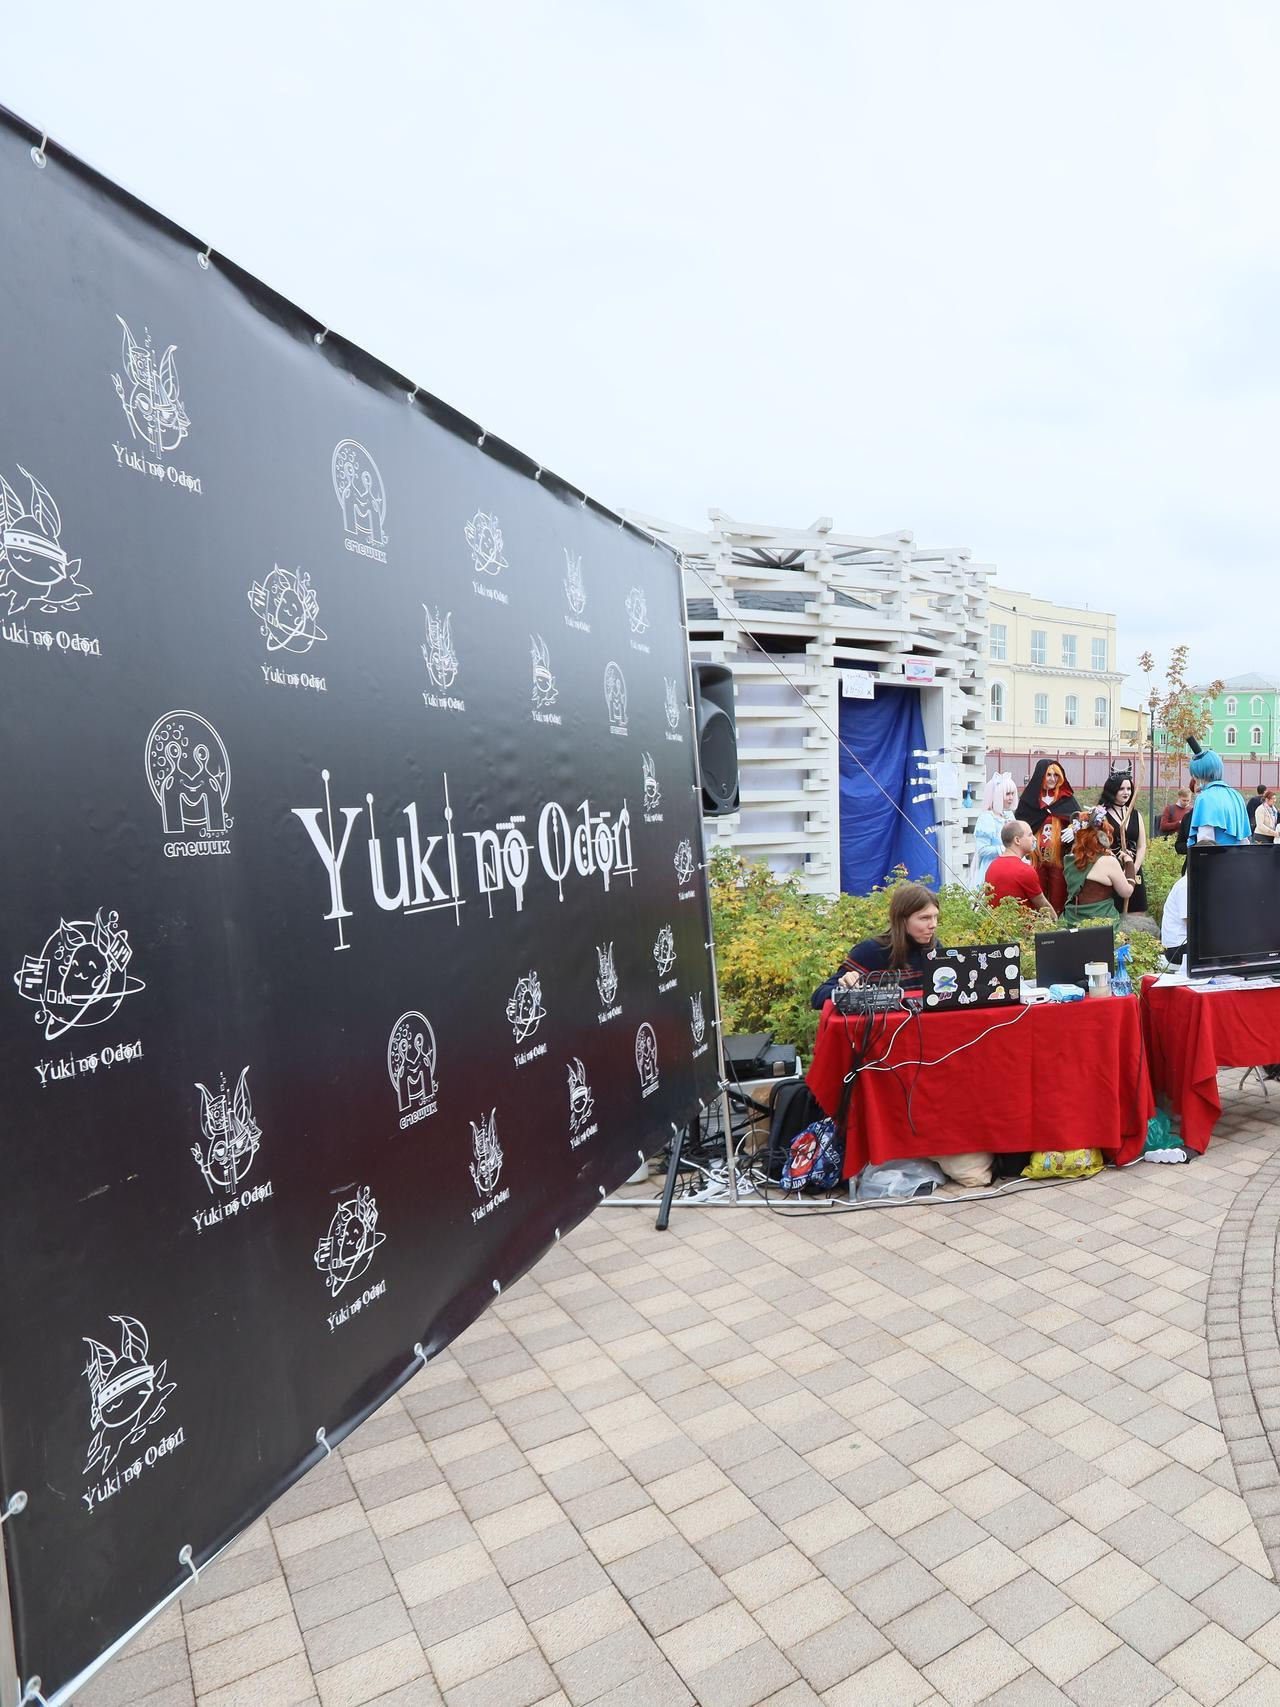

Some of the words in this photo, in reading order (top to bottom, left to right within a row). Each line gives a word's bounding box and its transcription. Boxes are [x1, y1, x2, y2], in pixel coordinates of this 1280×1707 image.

[112, 441, 147, 474] Yuki
[0, 618, 30, 648] uki
[260, 662, 287, 686] Yuki
[291, 769, 466, 951] Yuki
[34, 1051, 77, 1089] Yuki
[191, 1200, 224, 1235] Yuki
[326, 1304, 350, 1334] Yuki
[82, 1465, 121, 1515] Yuki
